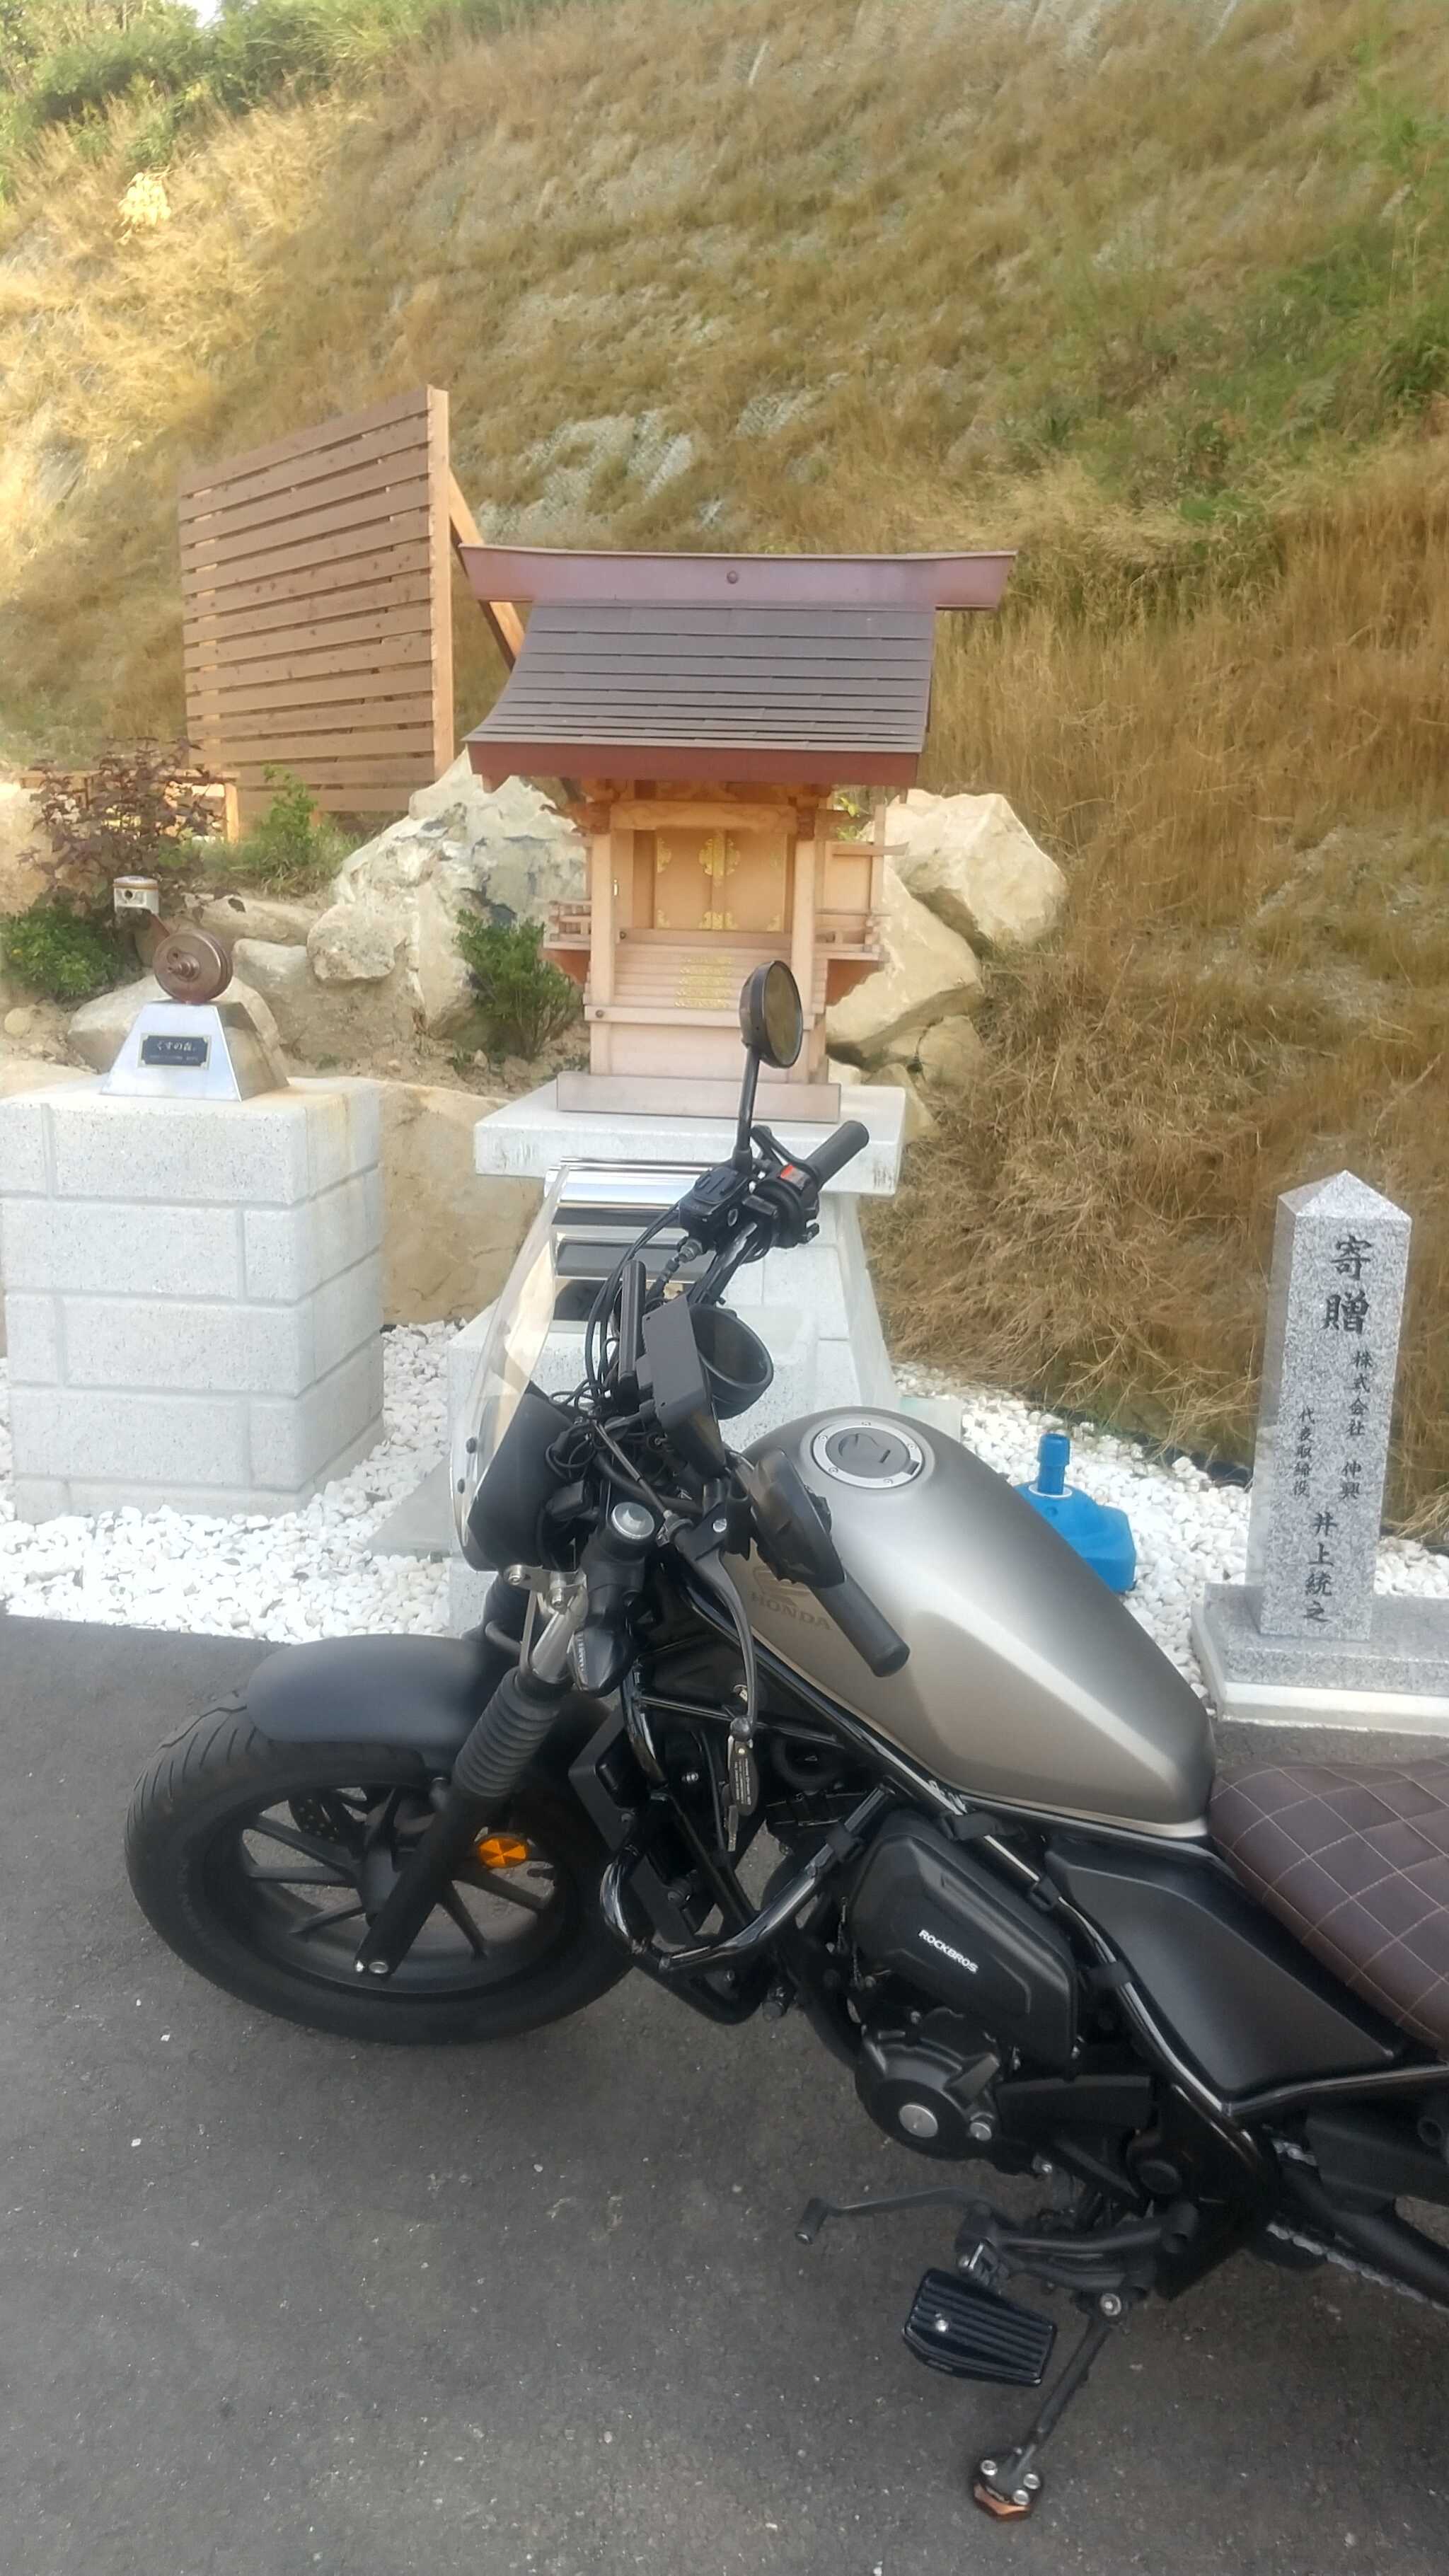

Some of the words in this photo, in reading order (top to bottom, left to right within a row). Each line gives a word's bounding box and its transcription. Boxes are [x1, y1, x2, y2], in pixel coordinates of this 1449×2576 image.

[1320, 1235, 1372, 1335] 寄贈
[1346, 1351, 1373, 1437] 株式会社
[1303, 1511, 1338, 1623] 井上統之
[749, 1591, 832, 1631] HONDA
[918, 1929, 979, 1973] ROCKBROS
